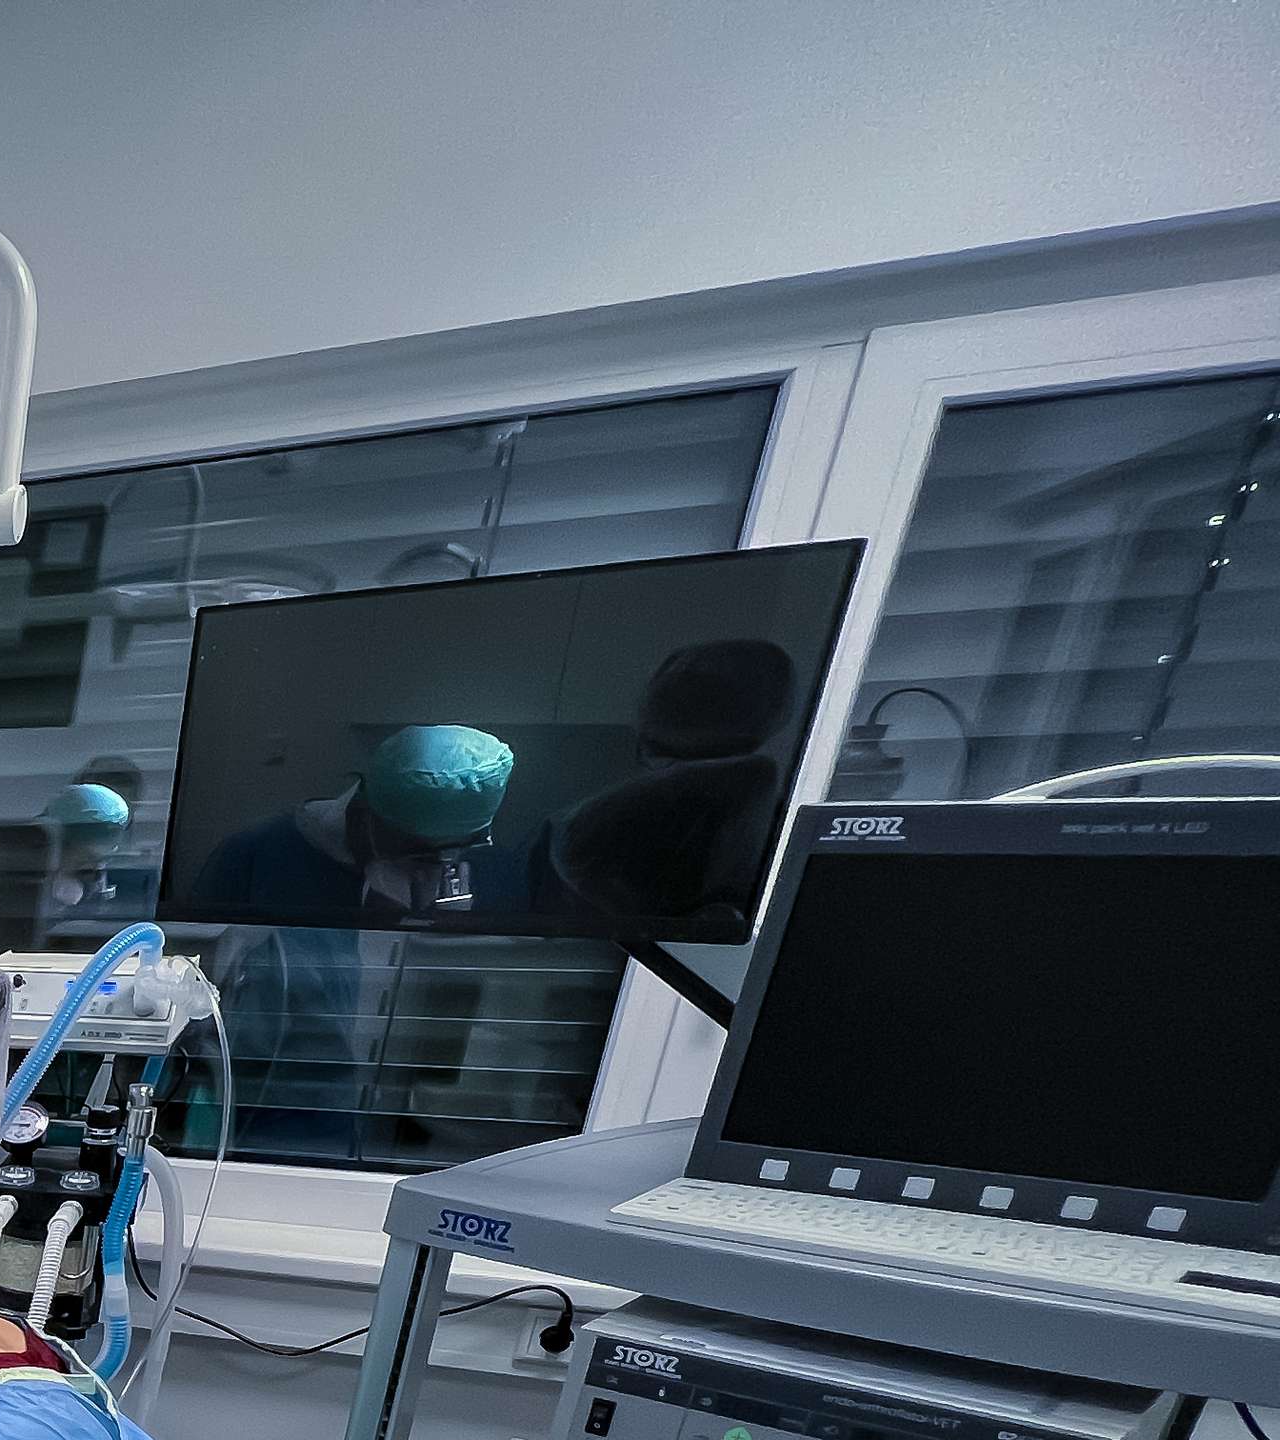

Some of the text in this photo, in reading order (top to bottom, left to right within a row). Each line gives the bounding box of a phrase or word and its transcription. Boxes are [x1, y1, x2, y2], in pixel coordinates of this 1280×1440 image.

[830, 816, 905, 835] STORZ
[438, 1209, 511, 1243] STORZ
[613, 1345, 679, 1373] STORZ
